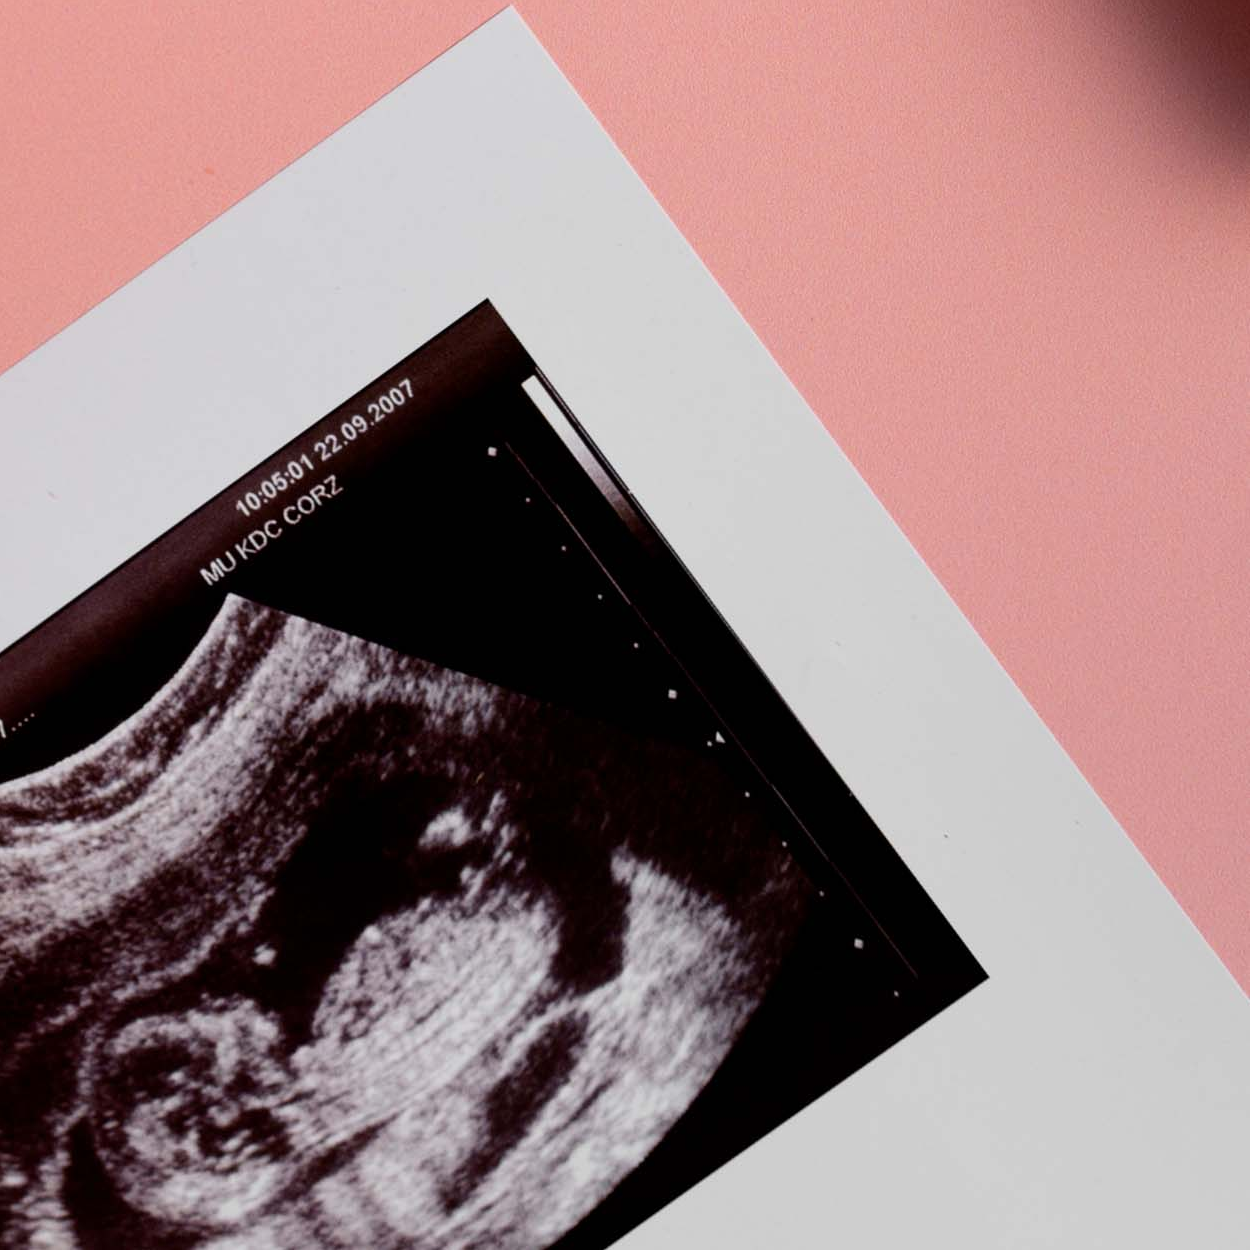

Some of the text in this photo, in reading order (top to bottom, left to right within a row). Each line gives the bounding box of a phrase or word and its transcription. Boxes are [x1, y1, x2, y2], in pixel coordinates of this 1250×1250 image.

[235, 378, 414, 517] 10:05:01 22.09.2007
[199, 474, 343, 586] MU KDC CORZ
